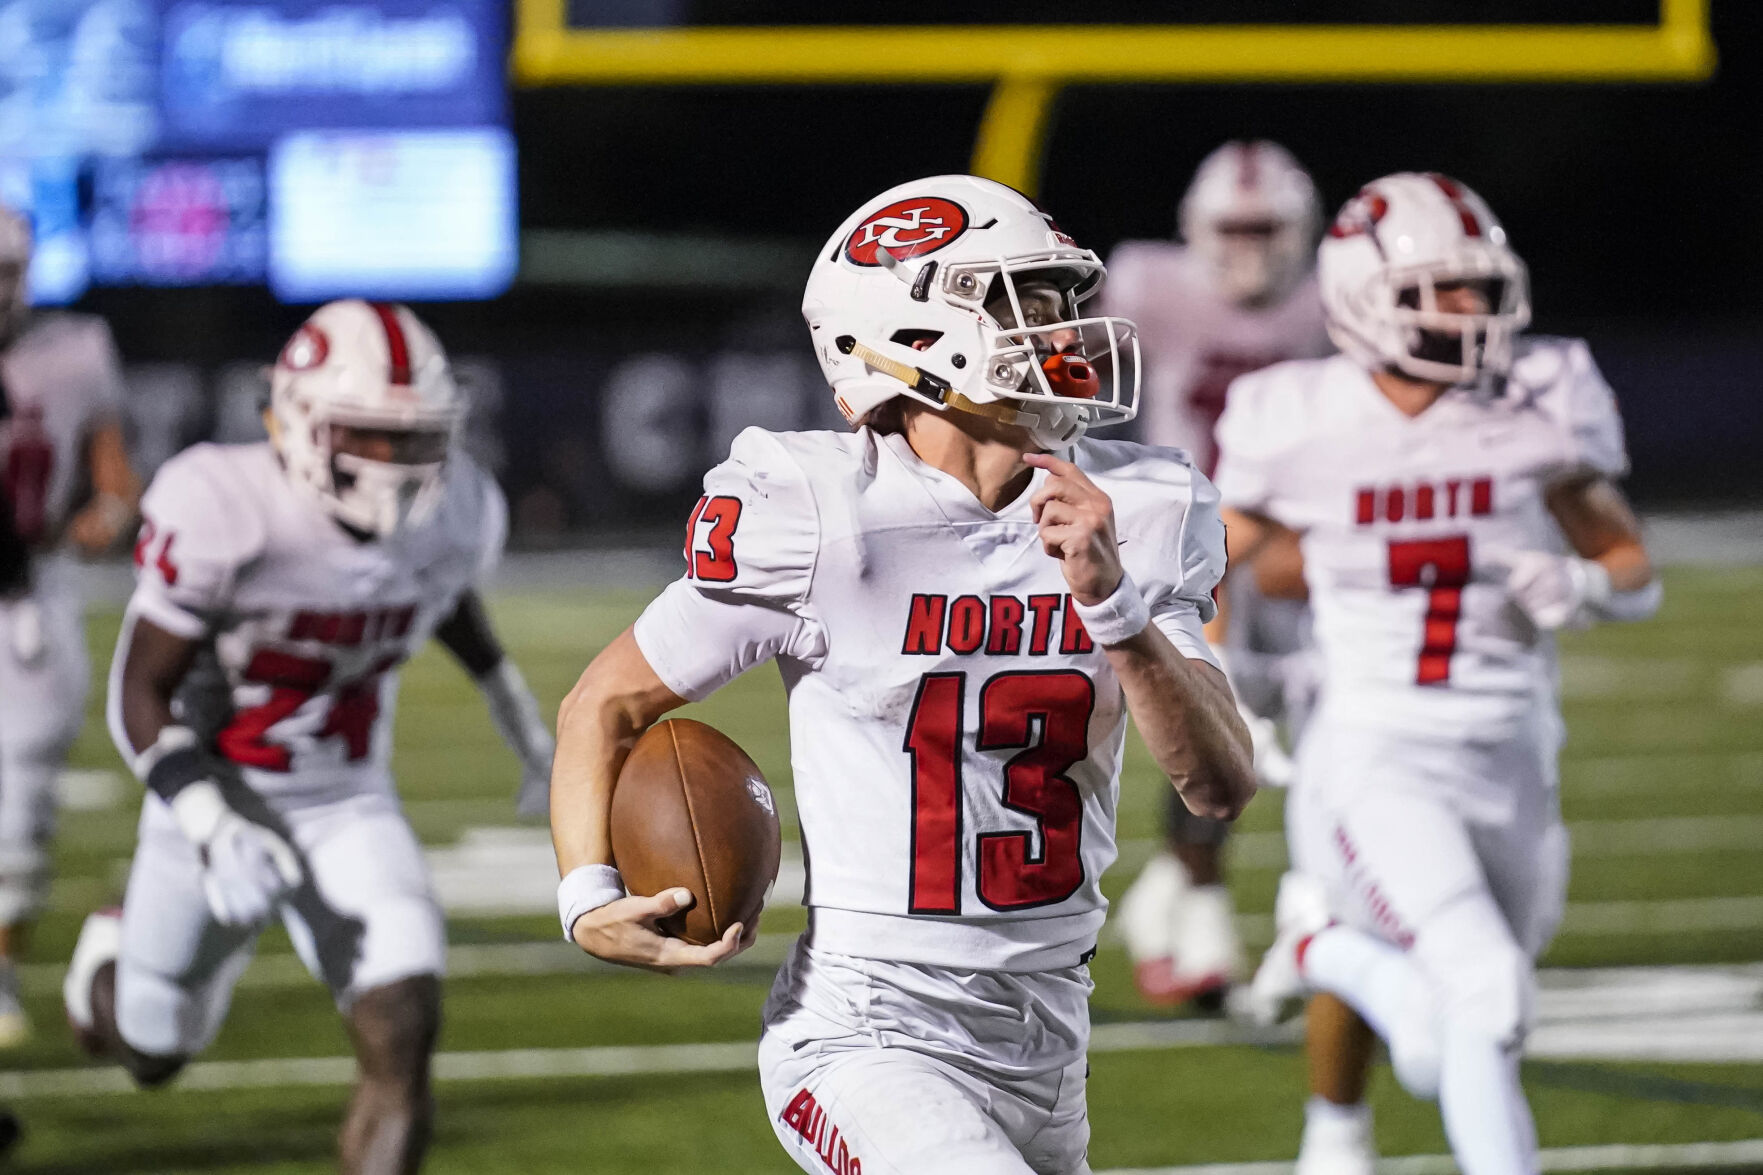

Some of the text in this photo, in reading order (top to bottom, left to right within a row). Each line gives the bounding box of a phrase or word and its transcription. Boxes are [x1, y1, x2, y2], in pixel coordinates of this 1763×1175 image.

[684, 495, 743, 582] 13
[1355, 478, 1493, 526] NORTH
[901, 593, 1095, 655] NORTH
[1388, 535, 1471, 686] 7
[217, 648, 405, 772] 24
[902, 669, 1096, 915] 13
